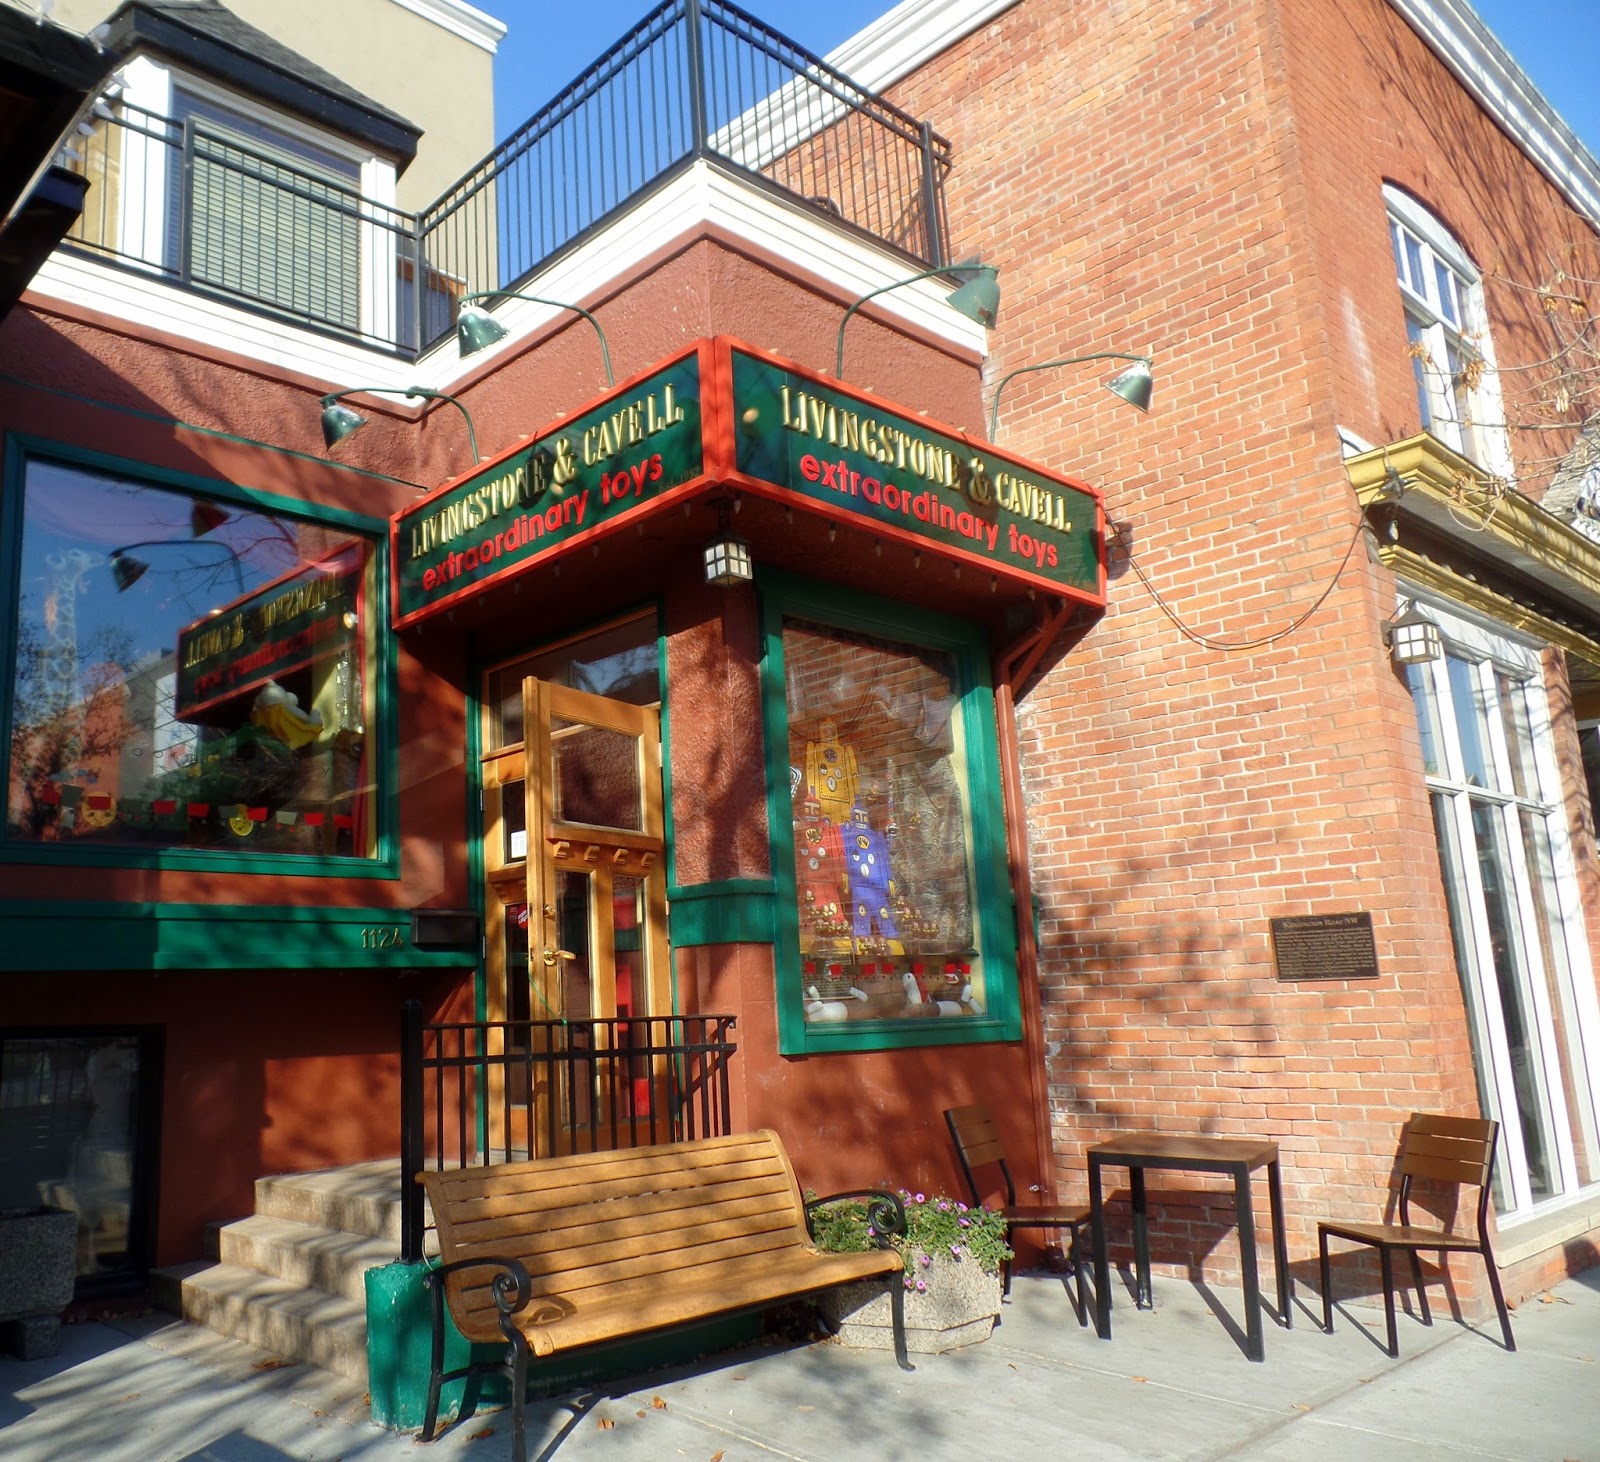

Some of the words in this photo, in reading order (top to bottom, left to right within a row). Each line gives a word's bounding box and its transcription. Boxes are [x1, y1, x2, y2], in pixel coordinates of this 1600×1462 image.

[411, 453, 547, 560] LIVINGSTONE
[553, 437, 577, 485] &
[584, 383, 684, 466] CAVELL
[422, 489, 589, 591] extraordinary
[600, 453, 664, 505] toys
[780, 384, 961, 491] LIVINGSTONE
[969, 456, 992, 506] &
[996, 472, 1073, 534] CAVELL
[800, 454, 998, 552] extraordinary
[1009, 523, 1059, 568] toys
[361, 928, 403, 949] 1124
